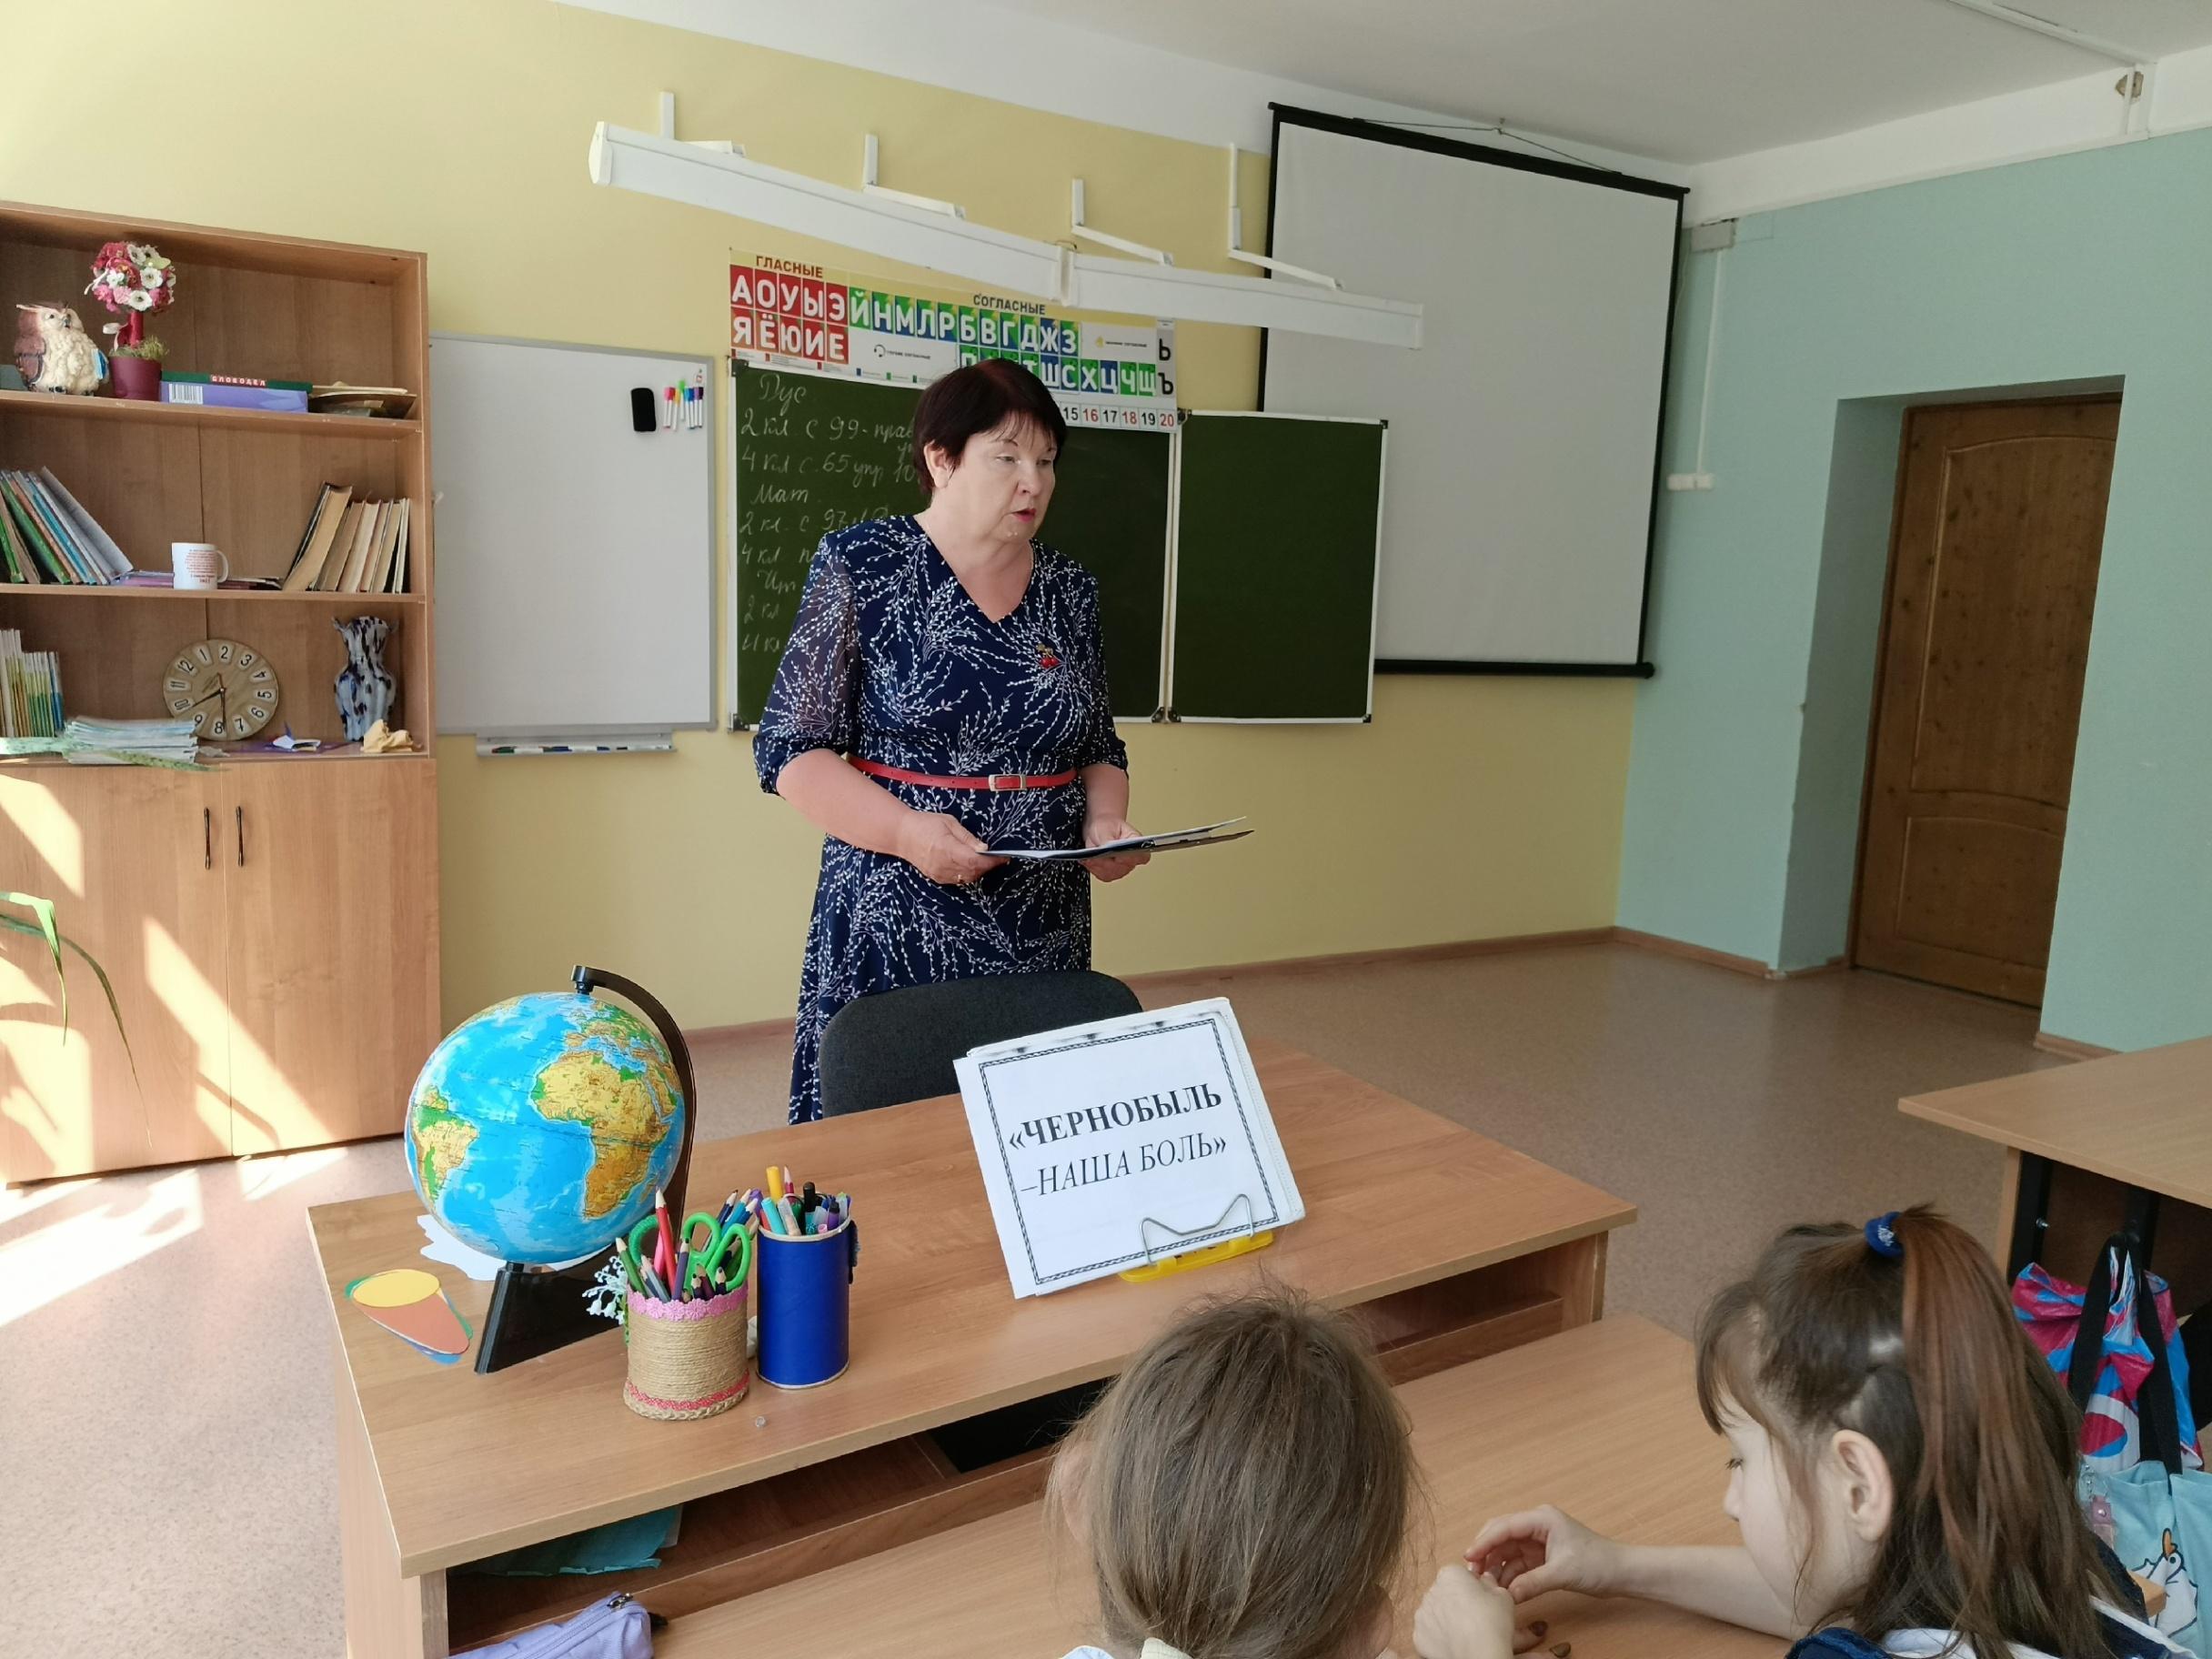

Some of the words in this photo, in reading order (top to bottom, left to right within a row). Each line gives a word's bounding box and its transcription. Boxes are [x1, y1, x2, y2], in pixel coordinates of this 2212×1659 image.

[756, 255, 823, 278] ГЛАСНЫЕ
[973, 294, 1046, 316] СОГЛАСНЫЕ
[740, 407, 758, 437] 2
[1063, 407, 1079, 421] 15
[1082, 408, 1099, 423] 16
[1103, 409, 1118, 424] 17
[1122, 411, 1137, 426] 18
[1141, 412, 1156, 426] 19
[1160, 413, 1174, 427] 20
[741, 445, 756, 473] 4
[822, 451, 852, 473] 65
[739, 511, 753, 535] 2
[741, 544, 753, 565] 4
[220, 646, 229, 659] 2
[176, 659, 195, 674] 12
[240, 654, 253, 667] 3
[254, 670, 266, 679] 4
[169, 680, 186, 689] 11
[256, 691, 272, 699] 5
[174, 699, 190, 710] 10
[251, 707, 265, 719] 6
[194, 714, 204, 727] 9
[214, 720, 225, 734] 8
[234, 718, 244, 731] 7
[1009, 1083, 1222, 1150] «ЧЕРНОБЫЛЬ
[1139, 1132, 1227, 1172] БОЛЬ»
